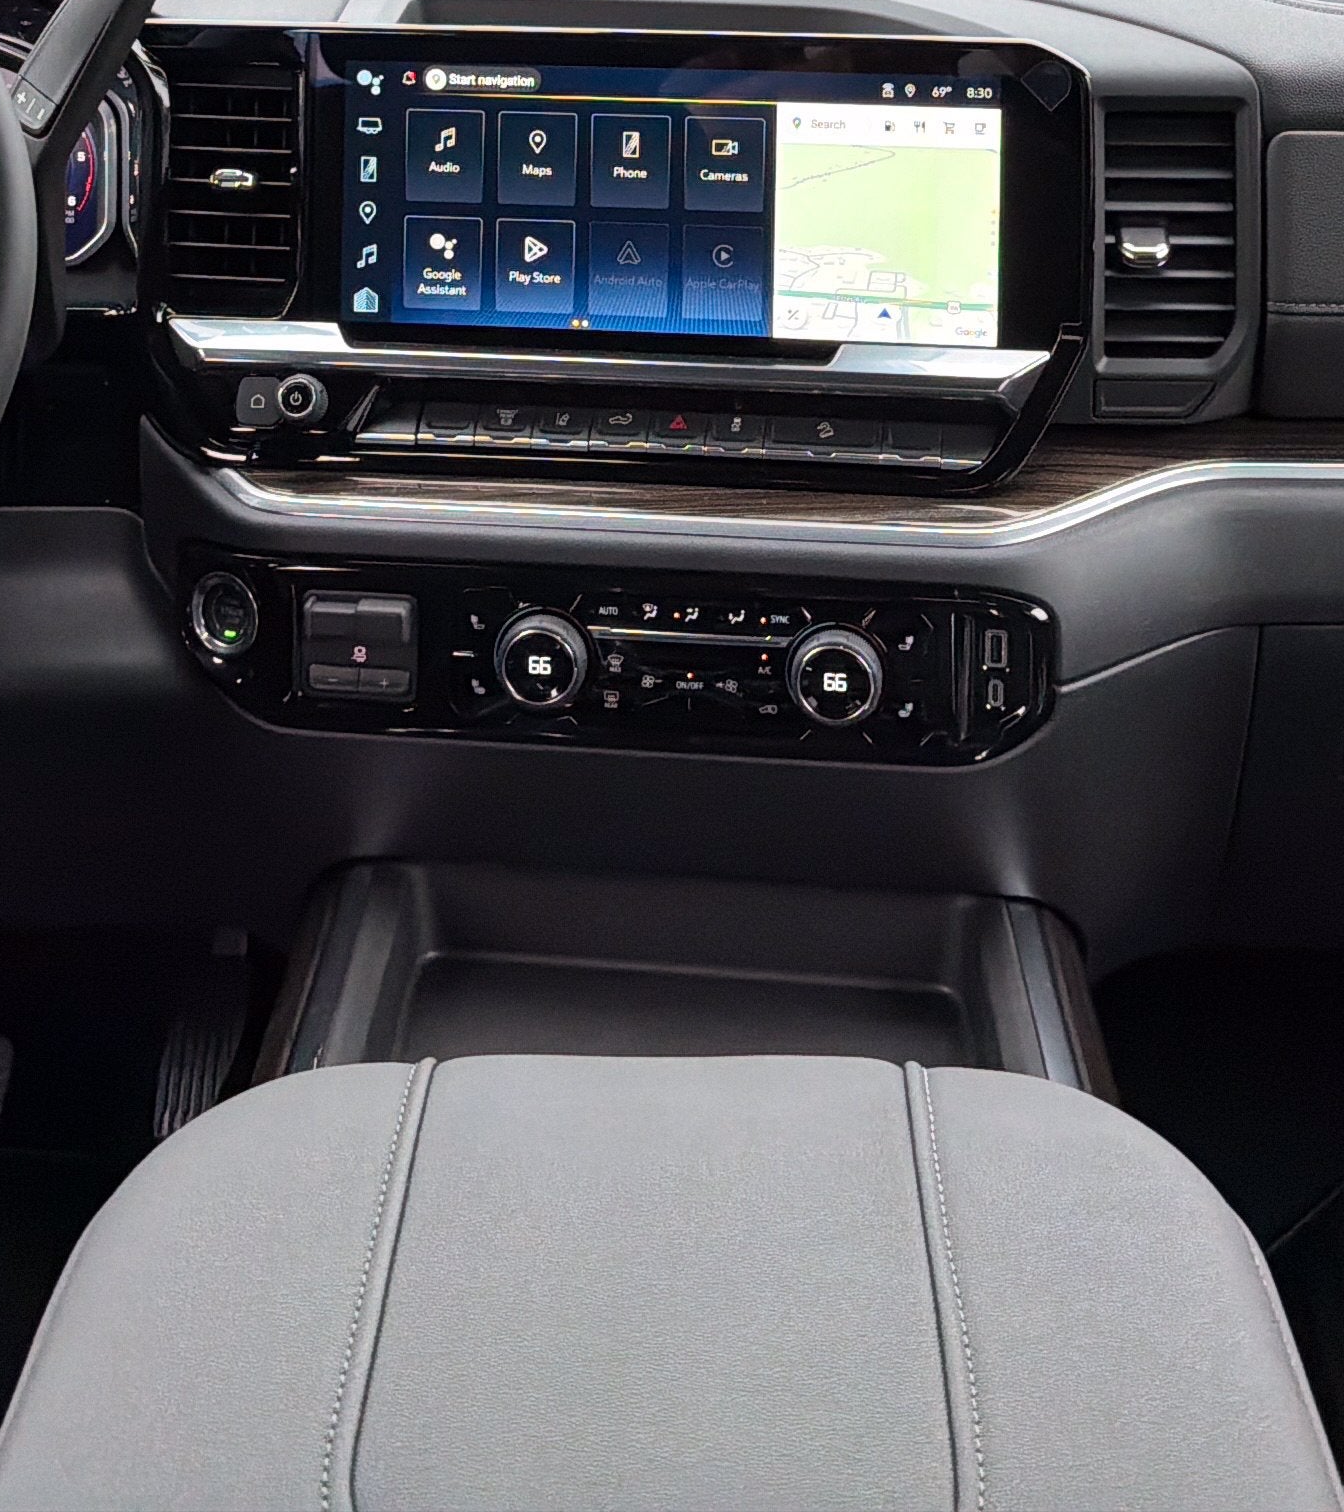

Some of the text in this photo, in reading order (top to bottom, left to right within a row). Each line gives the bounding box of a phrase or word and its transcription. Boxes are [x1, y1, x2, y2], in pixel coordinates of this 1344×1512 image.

[449, 73, 535, 89] Start navigation
[932, 86, 992, 99] 69° 8:30
[810, 119, 846, 130] Search
[76, 151, 86, 162] 5
[428, 161, 460, 174] Audio
[522, 164, 552, 178] Maps
[613, 167, 647, 179] Phone
[699, 169, 749, 183] Cameras
[67, 195, 76, 206] 6
[422, 268, 462, 283] Google
[508, 271, 561, 286] Play Store
[594, 274, 663, 288] Android Auto
[417, 284, 467, 296] Assistant
[685, 277, 761, 292] Apple CarPlay
[955, 325, 988, 339] Google
[598, 606, 618, 616] AUTO
[770, 615, 790, 625] SYNC
[528, 655, 551, 675] 66
[758, 666, 772, 675] A/C
[676, 680, 704, 690] ON/OFF
[823, 673, 847, 692] 66
